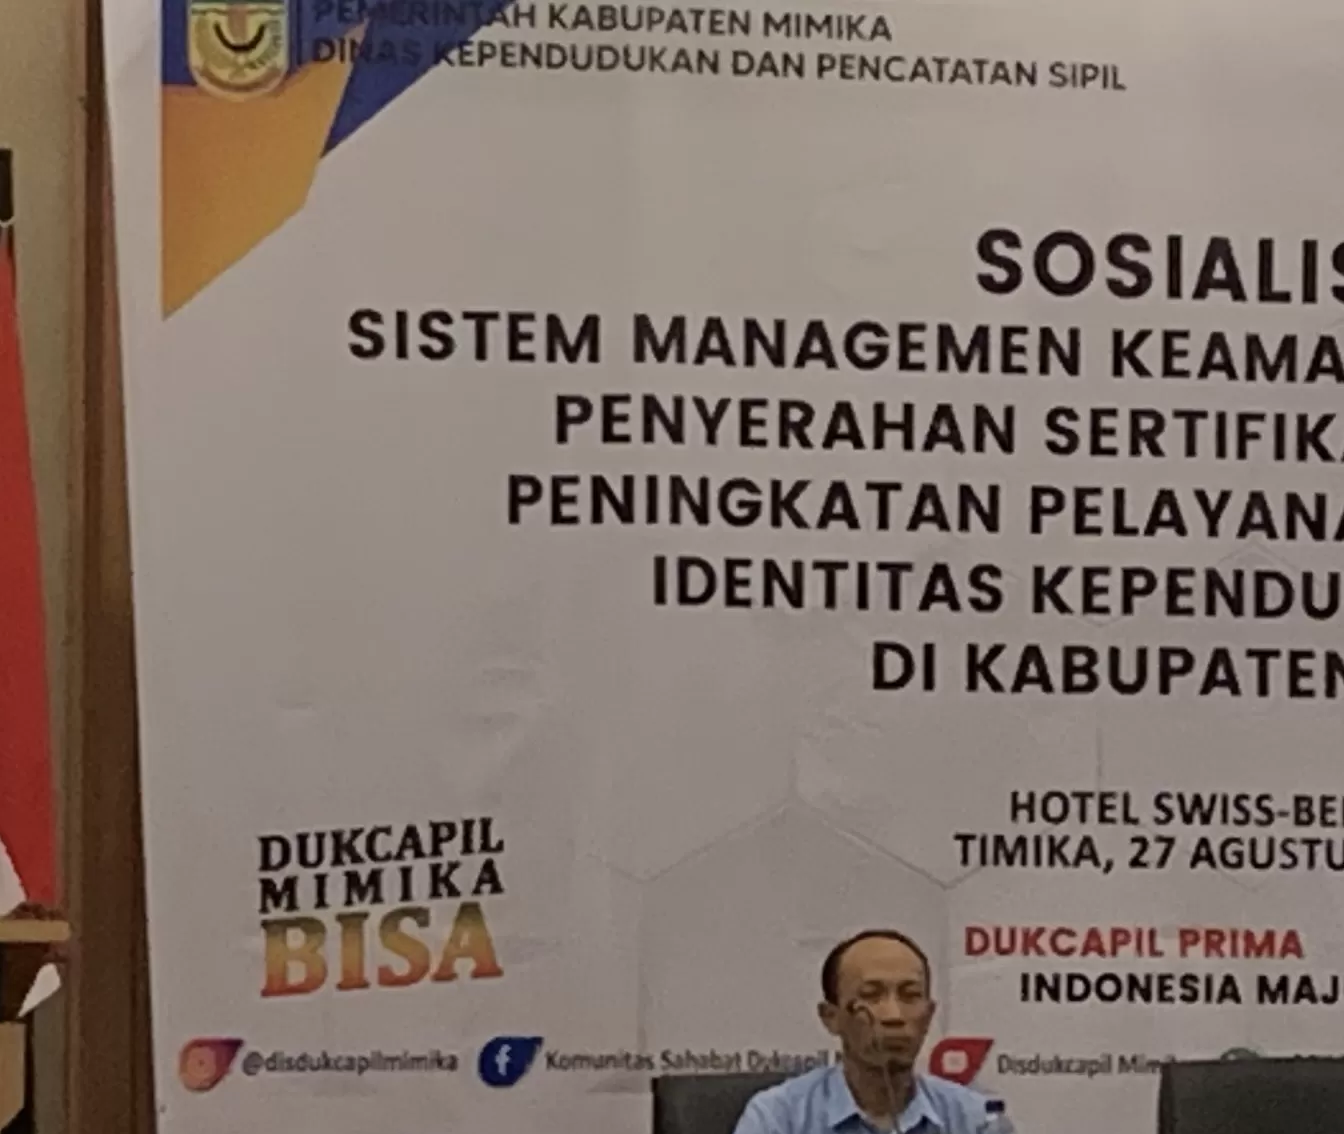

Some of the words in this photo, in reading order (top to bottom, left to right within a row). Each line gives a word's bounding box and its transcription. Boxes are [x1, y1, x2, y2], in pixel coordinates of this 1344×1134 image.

[549, 4, 751, 36] KABUPATEN
[763, 12, 893, 42] MIMIKA
[313, 36, 422, 66] DINAS
[434, 40, 720, 76] KEPENDUDUKAN
[732, 50, 805, 79] DAN
[817, 53, 1037, 88] PENCATATAN
[1049, 61, 1127, 91] SIPIL
[348, 308, 602, 365] SISTEM
[632, 313, 1082, 377] MANAGEMEN
[555, 393, 1016, 455] PENYERAHAN
[507, 472, 1002, 534] PENINGKATAN
[653, 555, 1004, 614] IDENTITAS
[872, 640, 936, 693] DI
[1010, 790, 1139, 826] HOTEL
[257, 816, 505, 872] DUKCAPIL
[954, 833, 1115, 874] TIMIKA,
[1129, 835, 1176, 869] 27
[258, 858, 505, 914] MIMIKA
[260, 901, 505, 998] BISA
[964, 926, 1165, 958] DUKCAPIL
[1178, 927, 1306, 960] PRIMA
[1019, 972, 1243, 1006] INDONESIA
[241, 1049, 459, 1077] @disdukcapilmimika
[545, 1050, 655, 1072] Komunitas
[997, 1053, 1113, 1079] Disdukcapil
